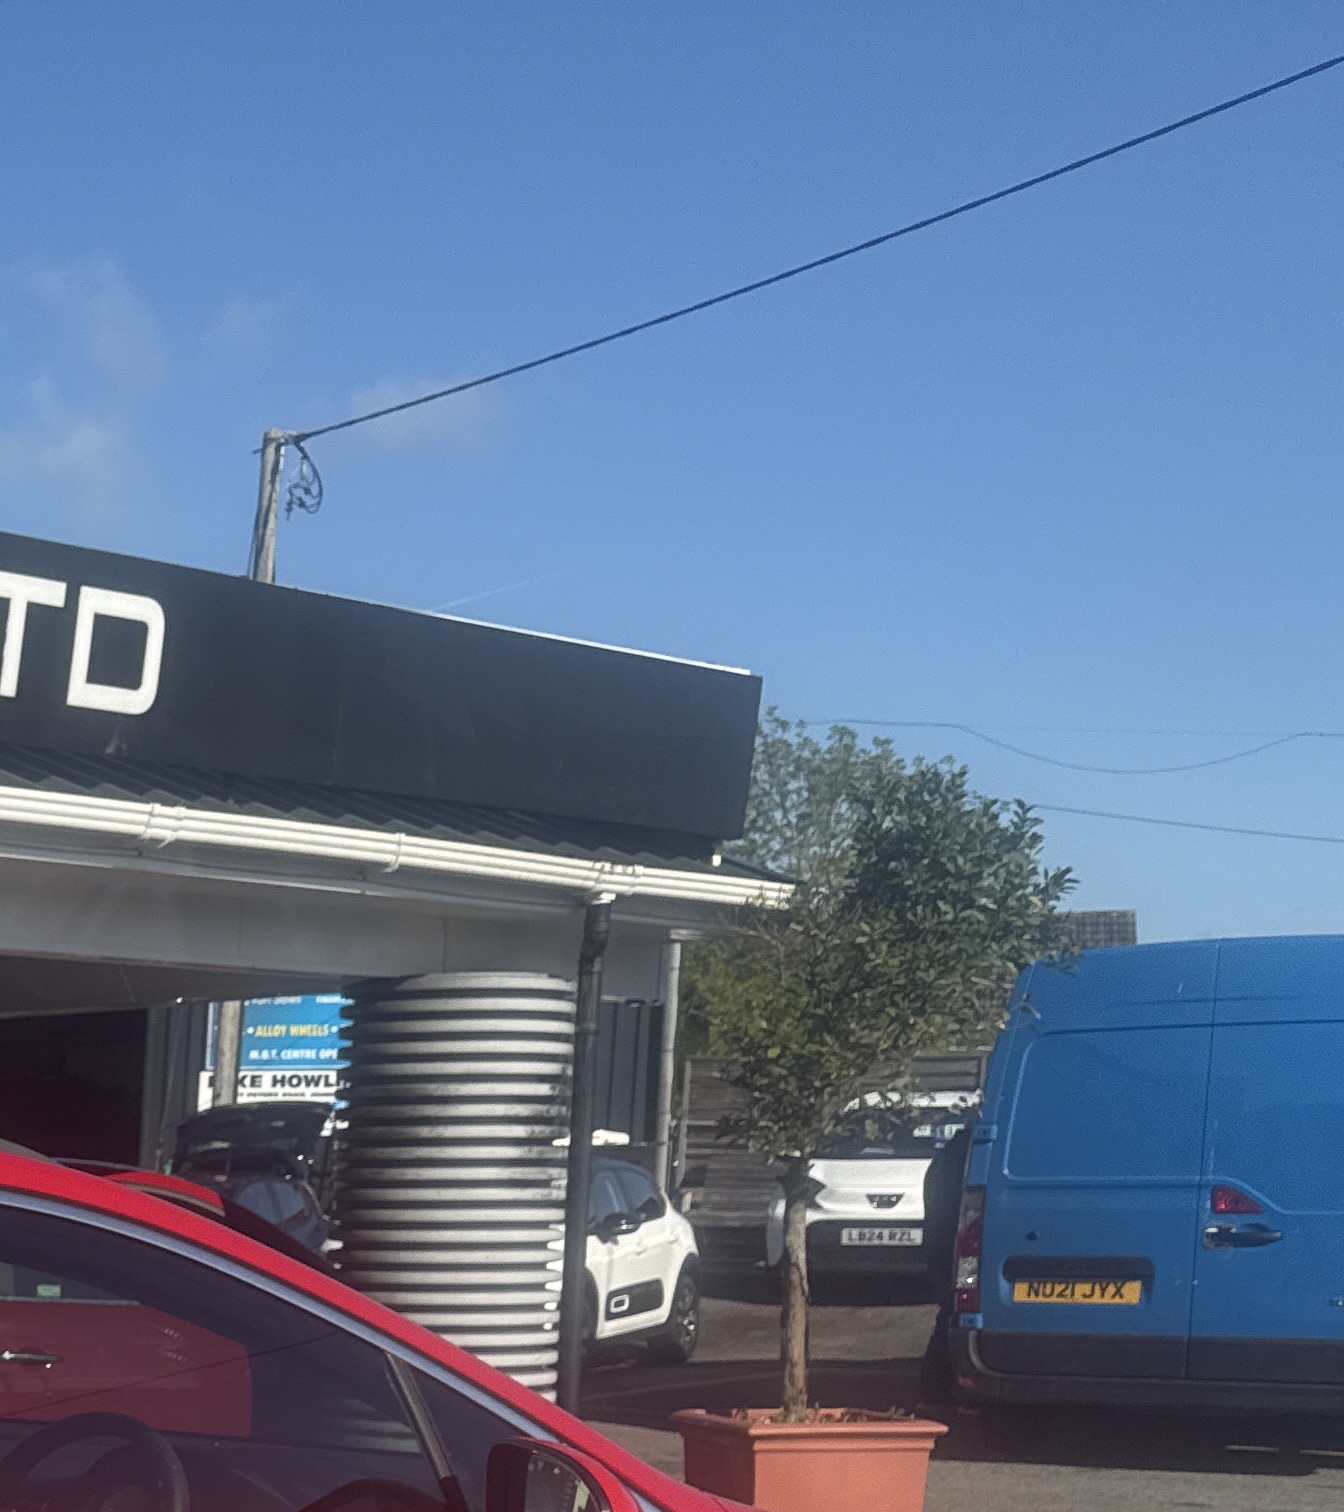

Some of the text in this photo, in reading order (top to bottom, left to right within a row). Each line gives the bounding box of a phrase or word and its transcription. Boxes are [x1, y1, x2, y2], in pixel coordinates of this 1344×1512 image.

[254, 1024, 287, 1037] ALLOY
[280, 1048, 317, 1060] CENTRE
[271, 1074, 340, 1088] HOWL
[1081, 1280, 1126, 1299] JYX
